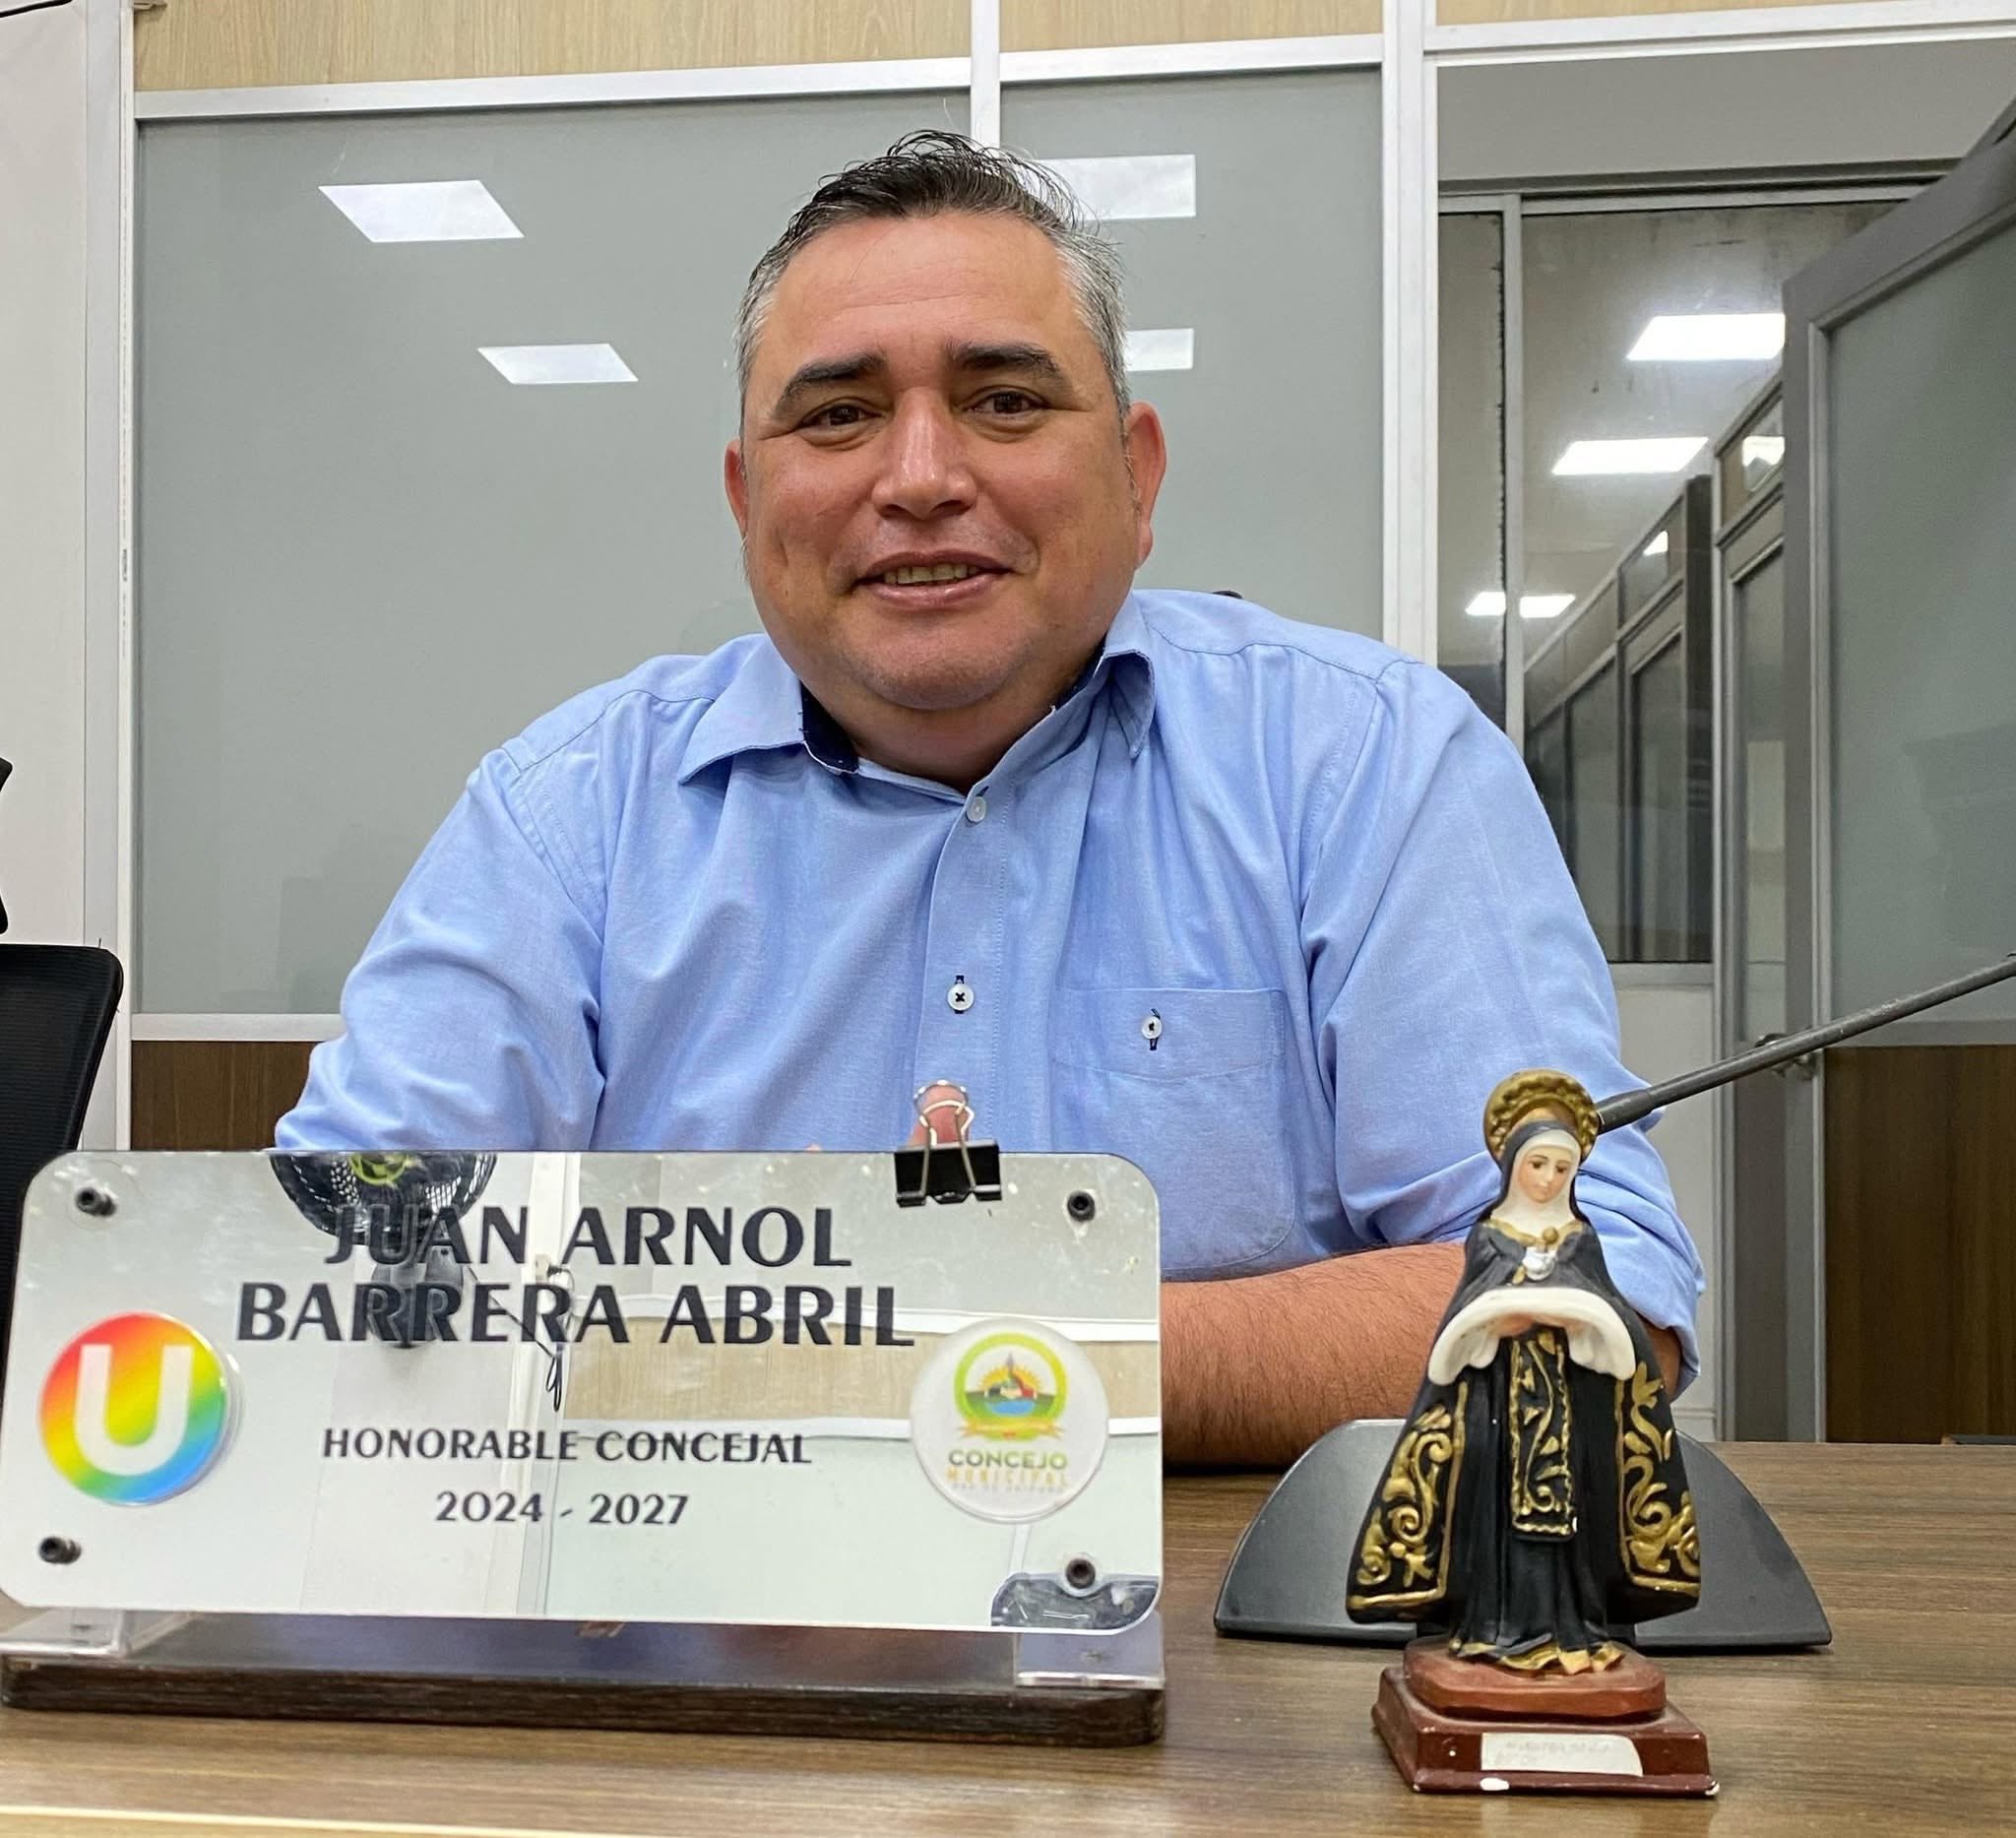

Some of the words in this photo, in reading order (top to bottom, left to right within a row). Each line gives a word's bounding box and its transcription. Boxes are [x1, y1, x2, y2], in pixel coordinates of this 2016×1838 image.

[324, 1205, 530, 1265] JUAN
[561, 1206, 852, 1267] ARNOL
[237, 1283, 631, 1344] BARRERA
[659, 1285, 915, 1348] ABRIL
[323, 1427, 579, 1461] HONORABLE
[596, 1430, 812, 1464] CONCEJAL
[949, 1448, 1068, 1470] CONCEJO
[435, 1491, 543, 1523] 2024
[589, 1493, 690, 1525] 2027
